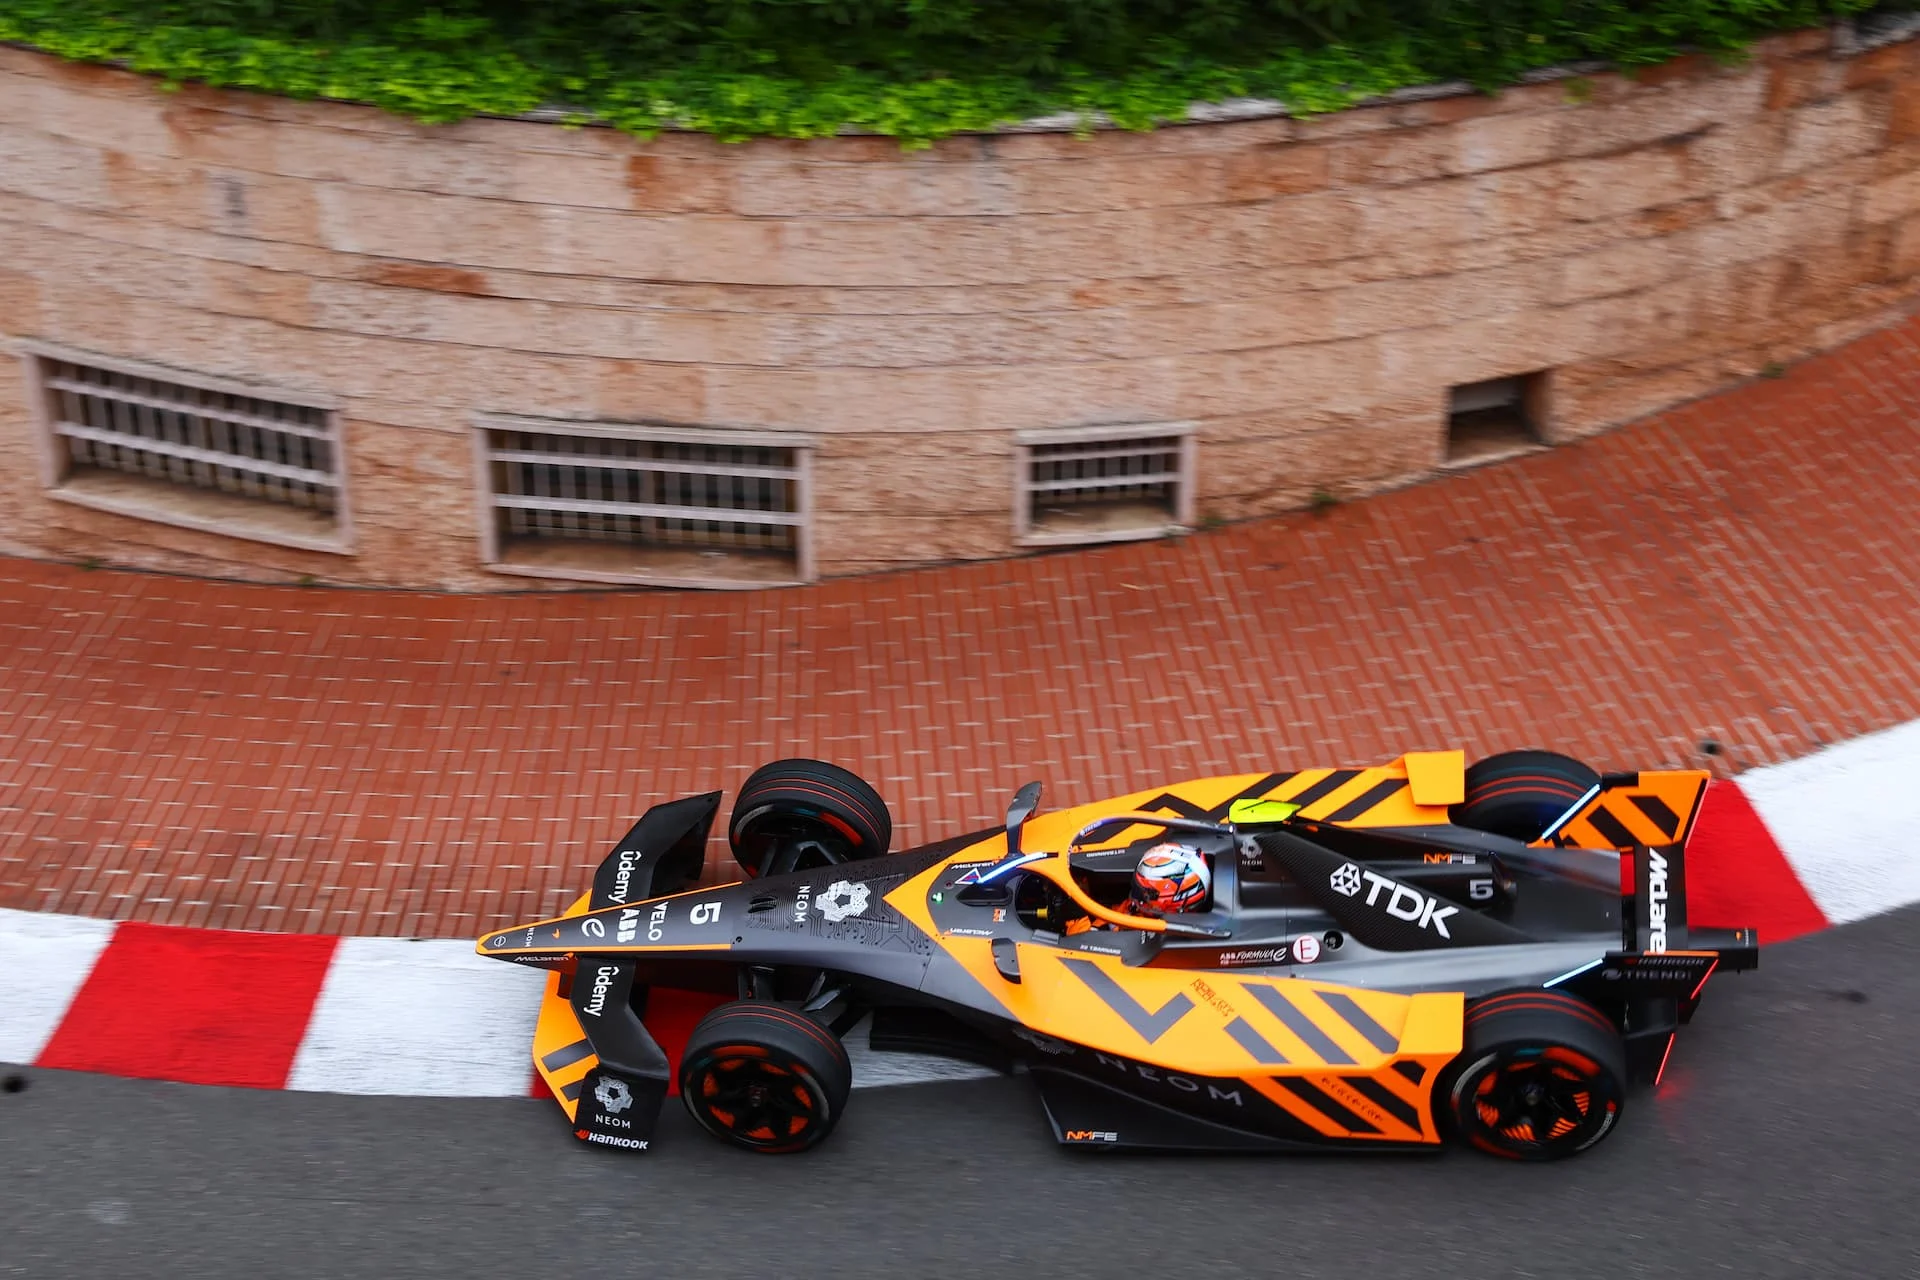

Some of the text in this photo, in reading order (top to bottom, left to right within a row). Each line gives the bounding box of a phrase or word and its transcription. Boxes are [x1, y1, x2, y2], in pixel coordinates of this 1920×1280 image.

[951, 862, 994, 870] McLaren
[1423, 853, 1476, 865] NMFE
[1469, 879, 1494, 900] 5
[1649, 847, 1668, 954] McLare
[690, 902, 722, 925] 5
[794, 885, 811, 922] NEOM
[1362, 869, 1460, 940] TDK
[617, 908, 640, 943] ABB
[647, 901, 669, 941] VELO
[1299, 938, 1313, 960] E
[1096, 1052, 1242, 1106] NEOM
[595, 1114, 631, 1129] NEOM
[1066, 1130, 1118, 1142] NMFE
